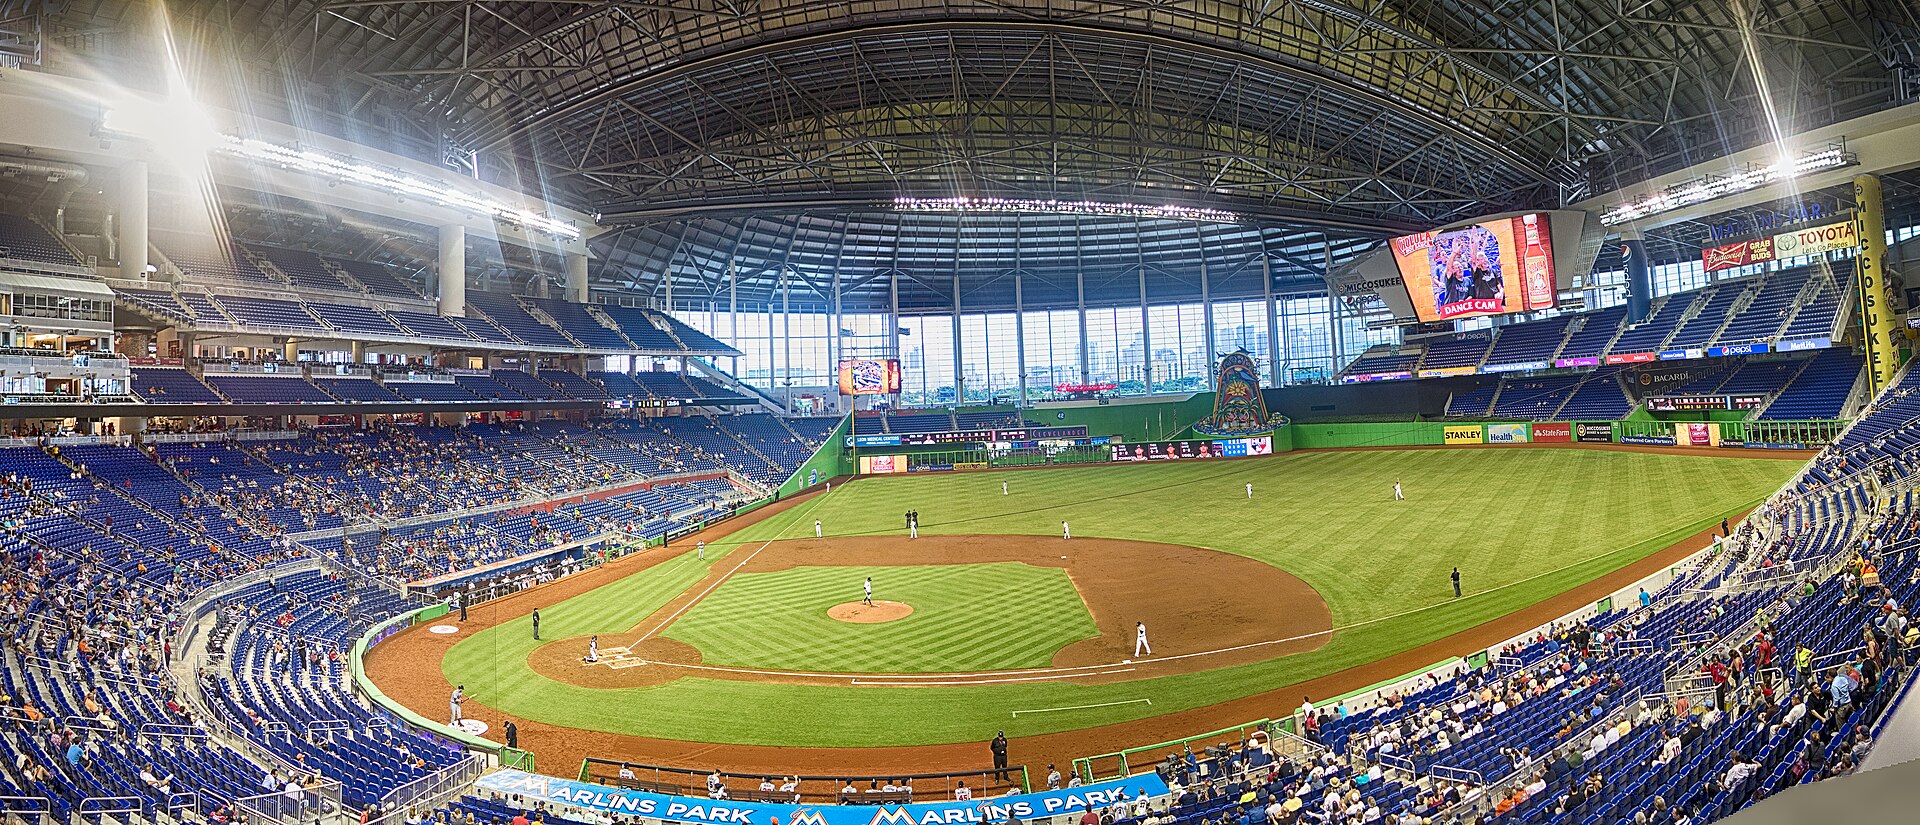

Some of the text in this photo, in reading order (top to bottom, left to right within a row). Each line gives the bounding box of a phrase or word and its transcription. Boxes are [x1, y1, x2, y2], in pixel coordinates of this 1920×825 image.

[1789, 202, 1836, 225] PARK
[1397, 231, 1433, 252] CHOLULA
[1798, 225, 1855, 246] TOYOTA
[1750, 239, 1771, 250] GRAB
[1802, 246, 1817, 255] Let's
[1828, 241, 1849, 250] Places
[1706, 249, 1747, 264] Budweiser
[1751, 251, 1772, 262] BUDS
[1345, 277, 1401, 292] MICCOSUKEE
[1856, 201, 1884, 383] MICCOSUKEE
[1444, 300, 1497, 315] DANCE CAM
[1730, 345, 1752, 356] pepsi
[1790, 341, 1816, 350] MetLife
[1445, 431, 1482, 439] STANLEY
[1672, 745, 1680, 757] 10
[1044, 785, 1132, 814] PARK
[665, 802, 758, 825] PARK
